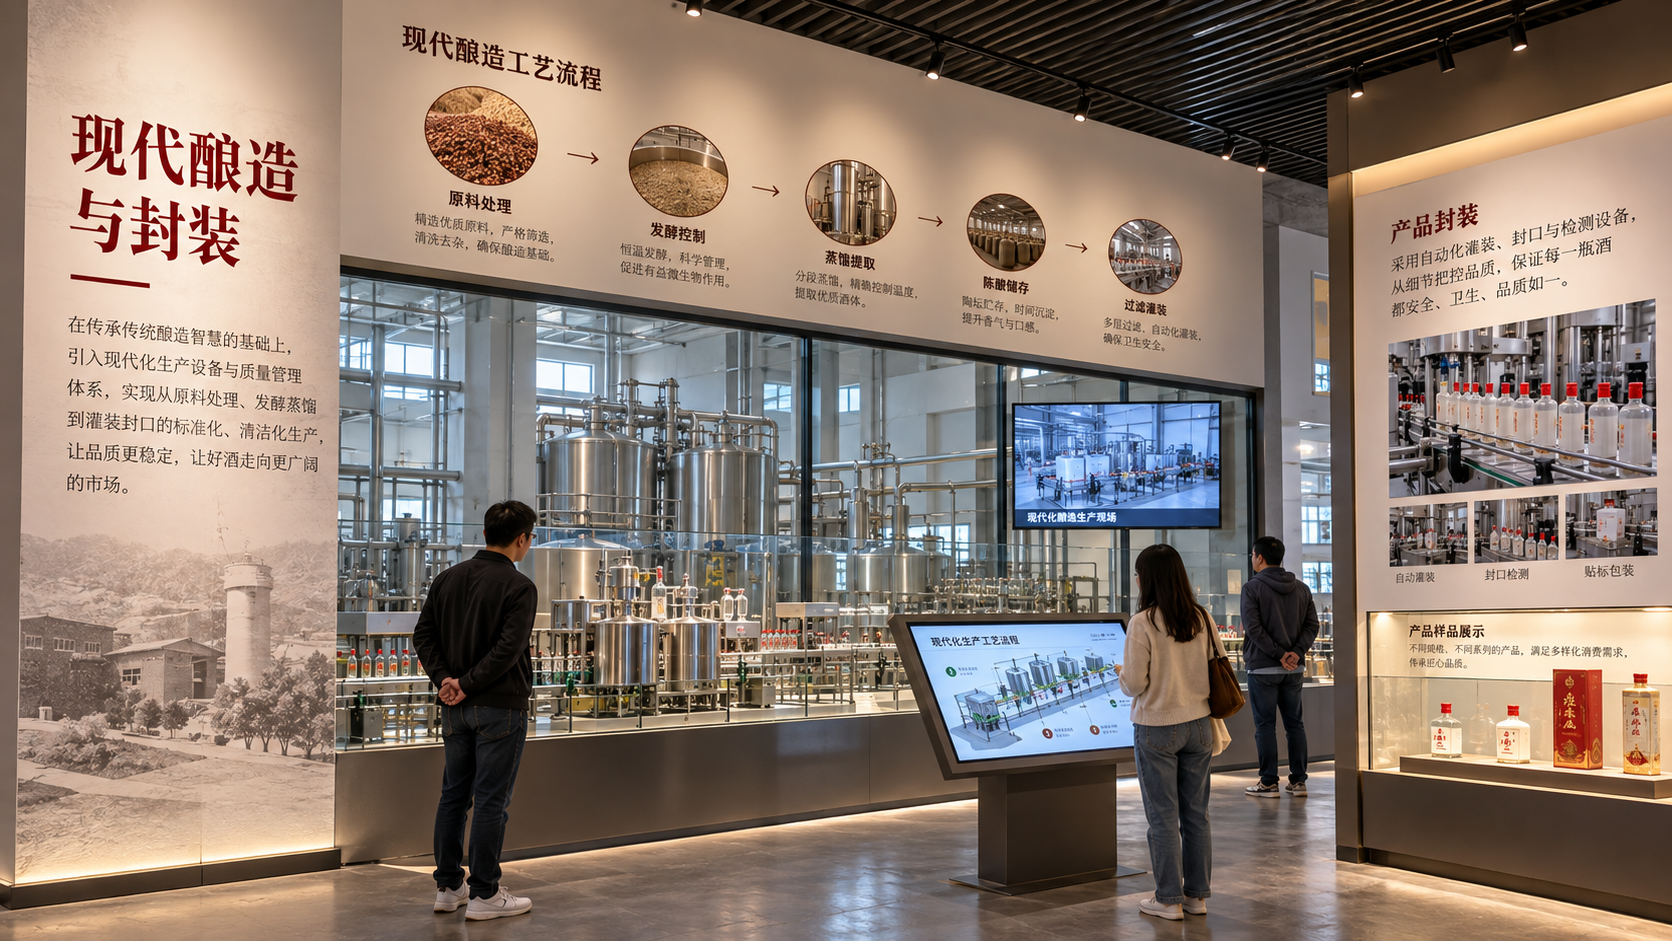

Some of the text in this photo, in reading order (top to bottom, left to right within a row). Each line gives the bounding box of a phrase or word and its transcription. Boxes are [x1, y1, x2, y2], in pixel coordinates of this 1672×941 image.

[401, 25, 601, 91] 现代酿造工艺流程
[70, 114, 298, 202] 现代酿造
[448, 191, 511, 214] 原料处理
[69, 188, 240, 267] 与封装
[650, 222, 705, 244] 发酵控制
[1390, 203, 1478, 244] 产品封装
[1391, 208, 1635, 271] 采用自动化灌装、封口与检测设备，
[825, 250, 875, 270] 蒸馏提取
[1391, 236, 1611, 294] 从细节把控品质，保证每一瓶酒
[983, 276, 1029, 294] 陈酿储存
[1391, 276, 1567, 317] 都安全、卫生、品质如一。
[1124, 299, 1166, 316] 过滤灌装
[67, 316, 290, 355] 在传承传统酿造智慧的基础上，
[68, 348, 301, 383] 引入现代化生产设备与质量管理
[66, 379, 316, 414] 体系，实现从原料处理、发酵蒸馏
[66, 411, 322, 444] 到灌装封口的标准化、清洁化生产，
[66, 442, 318, 472] 让品质更稳定，让好酒走向更广阔
[66, 474, 128, 494] 的市场。
[1484, 568, 1528, 580] 封口检测
[1584, 564, 1634, 577] 贴标包装
[1408, 624, 1484, 638] 产品样品展示
